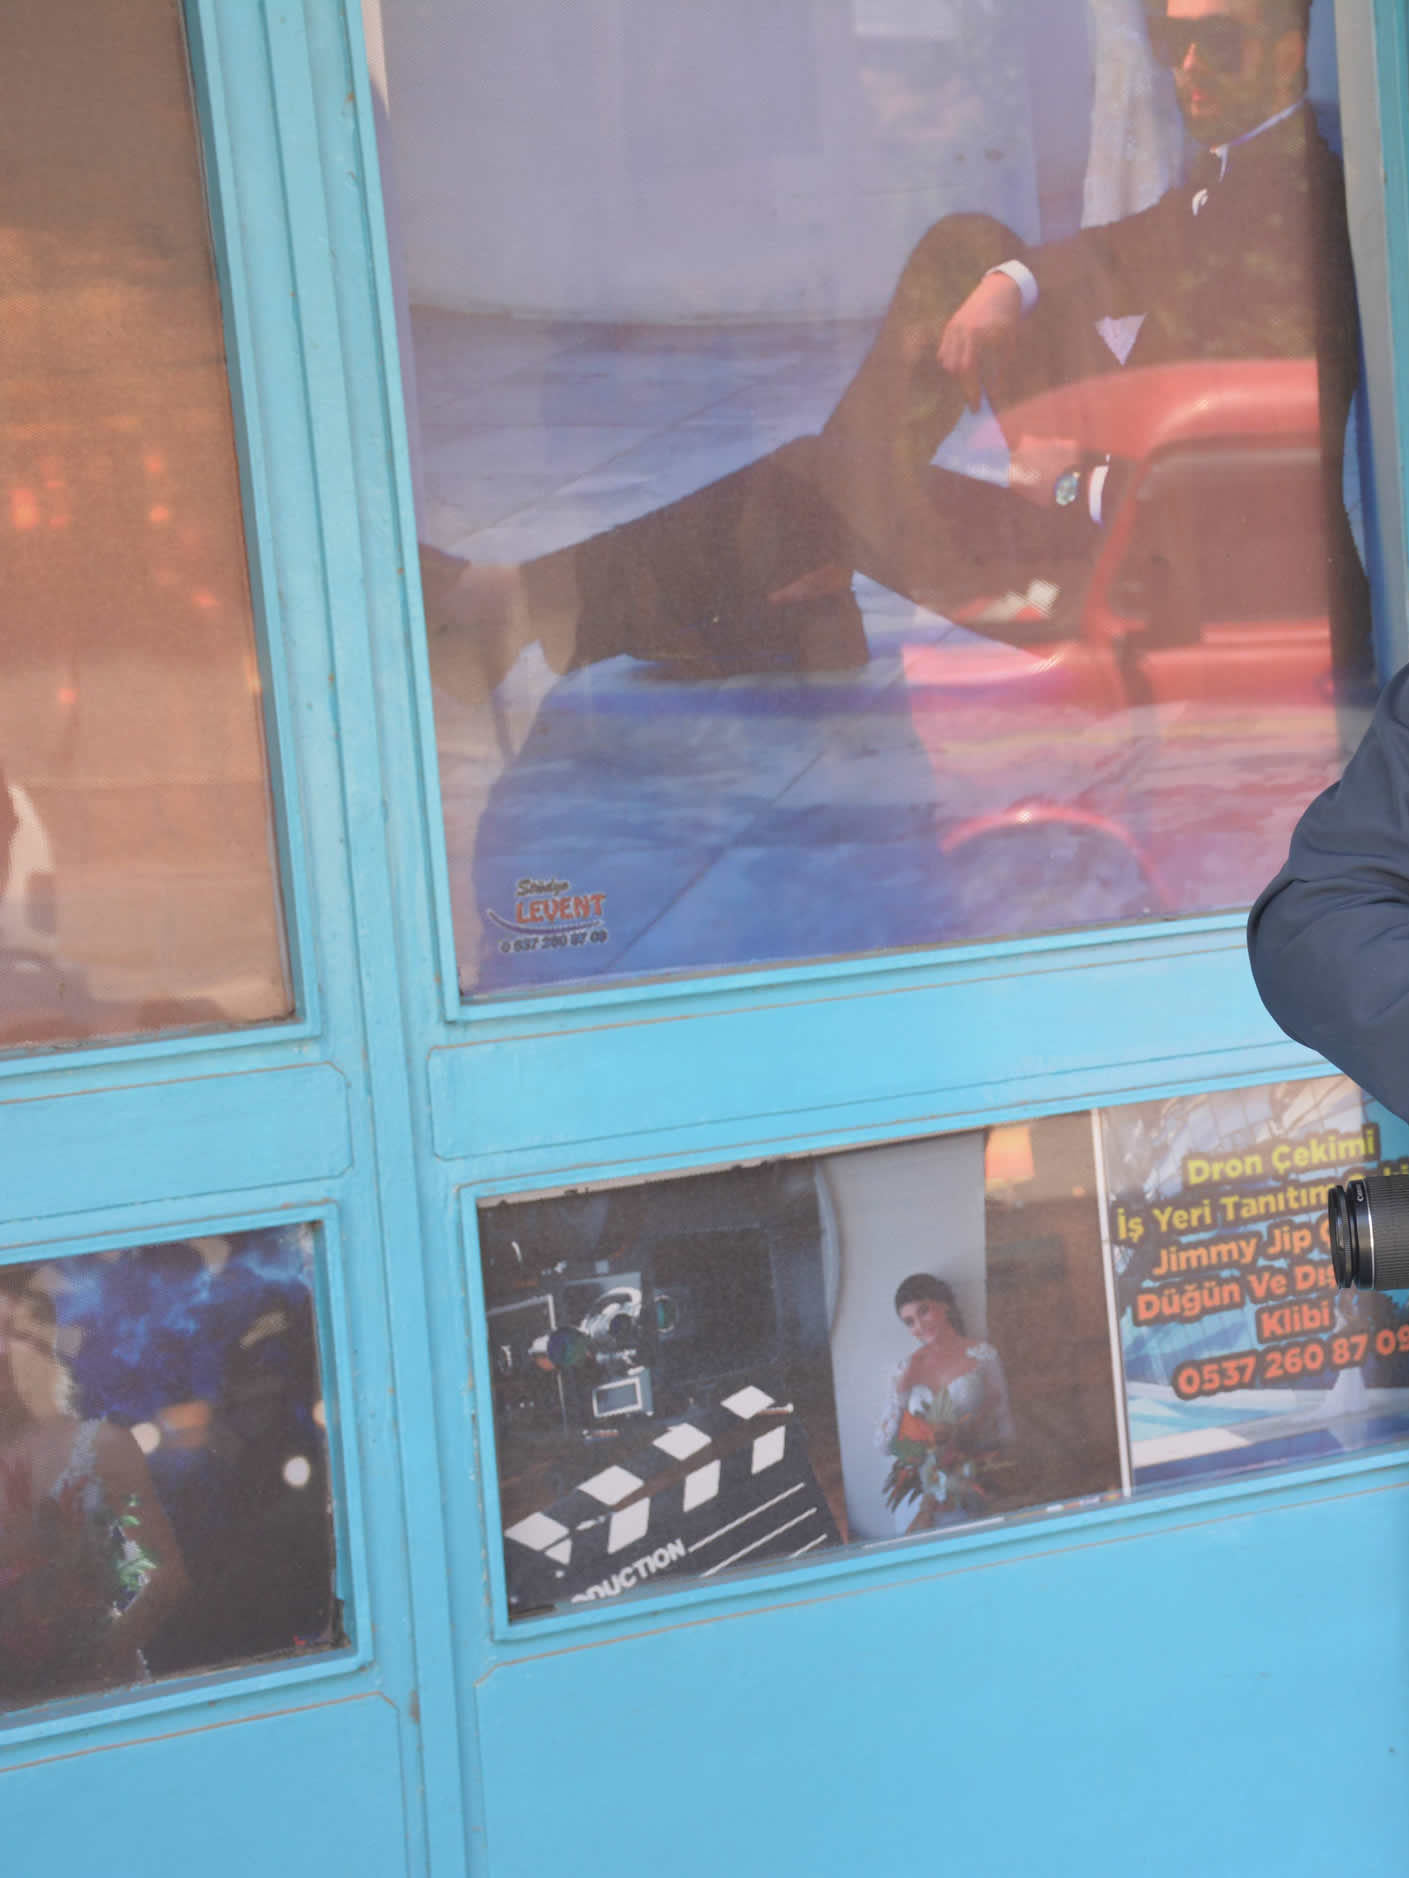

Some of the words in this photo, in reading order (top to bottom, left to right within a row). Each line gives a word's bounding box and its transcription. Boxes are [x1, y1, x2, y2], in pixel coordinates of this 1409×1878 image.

[516, 894, 607, 923] LEVENT
[1187, 1153, 1263, 1185] Dron
[1271, 1128, 1376, 1174] Çekimi
[1117, 1208, 1145, 1243] İş
[1153, 1200, 1211, 1235] Yeri
[1152, 1236, 1257, 1276] Jimmy
[1265, 1224, 1312, 1256] Jip
[1136, 1281, 1241, 1321] Düğün
[1248, 1273, 1289, 1297] Ve
[1261, 1305, 1331, 1339] Klibi
[1177, 1356, 1257, 1395] 0537
[1264, 1347, 1325, 1379] 260
[1332, 1334, 1369, 1366] 87
